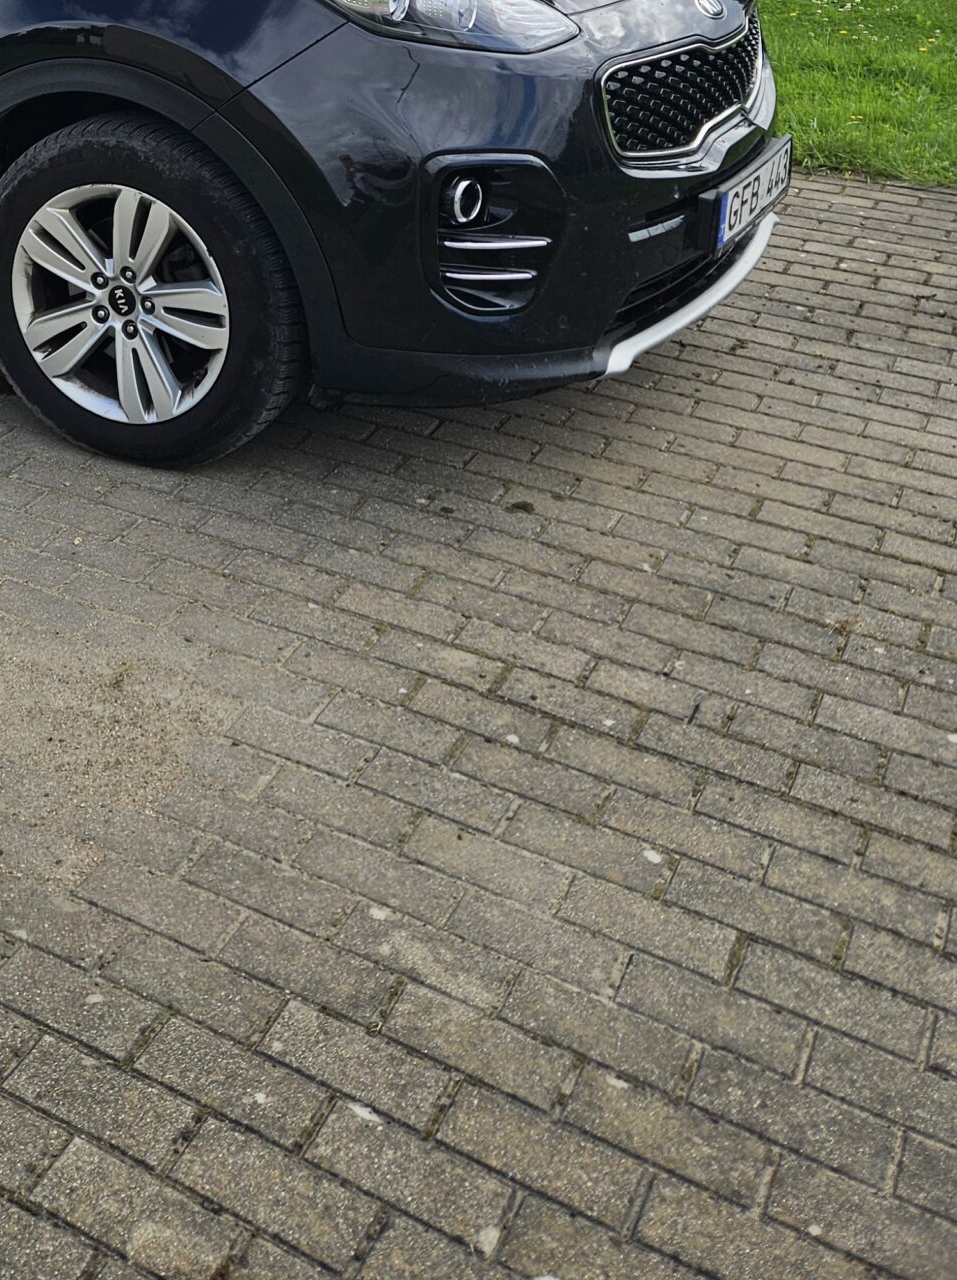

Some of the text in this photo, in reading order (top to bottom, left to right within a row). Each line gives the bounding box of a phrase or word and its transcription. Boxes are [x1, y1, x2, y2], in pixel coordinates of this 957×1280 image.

[728, 147, 789, 232] GFB 443
[114, 288, 129, 313] KIA
